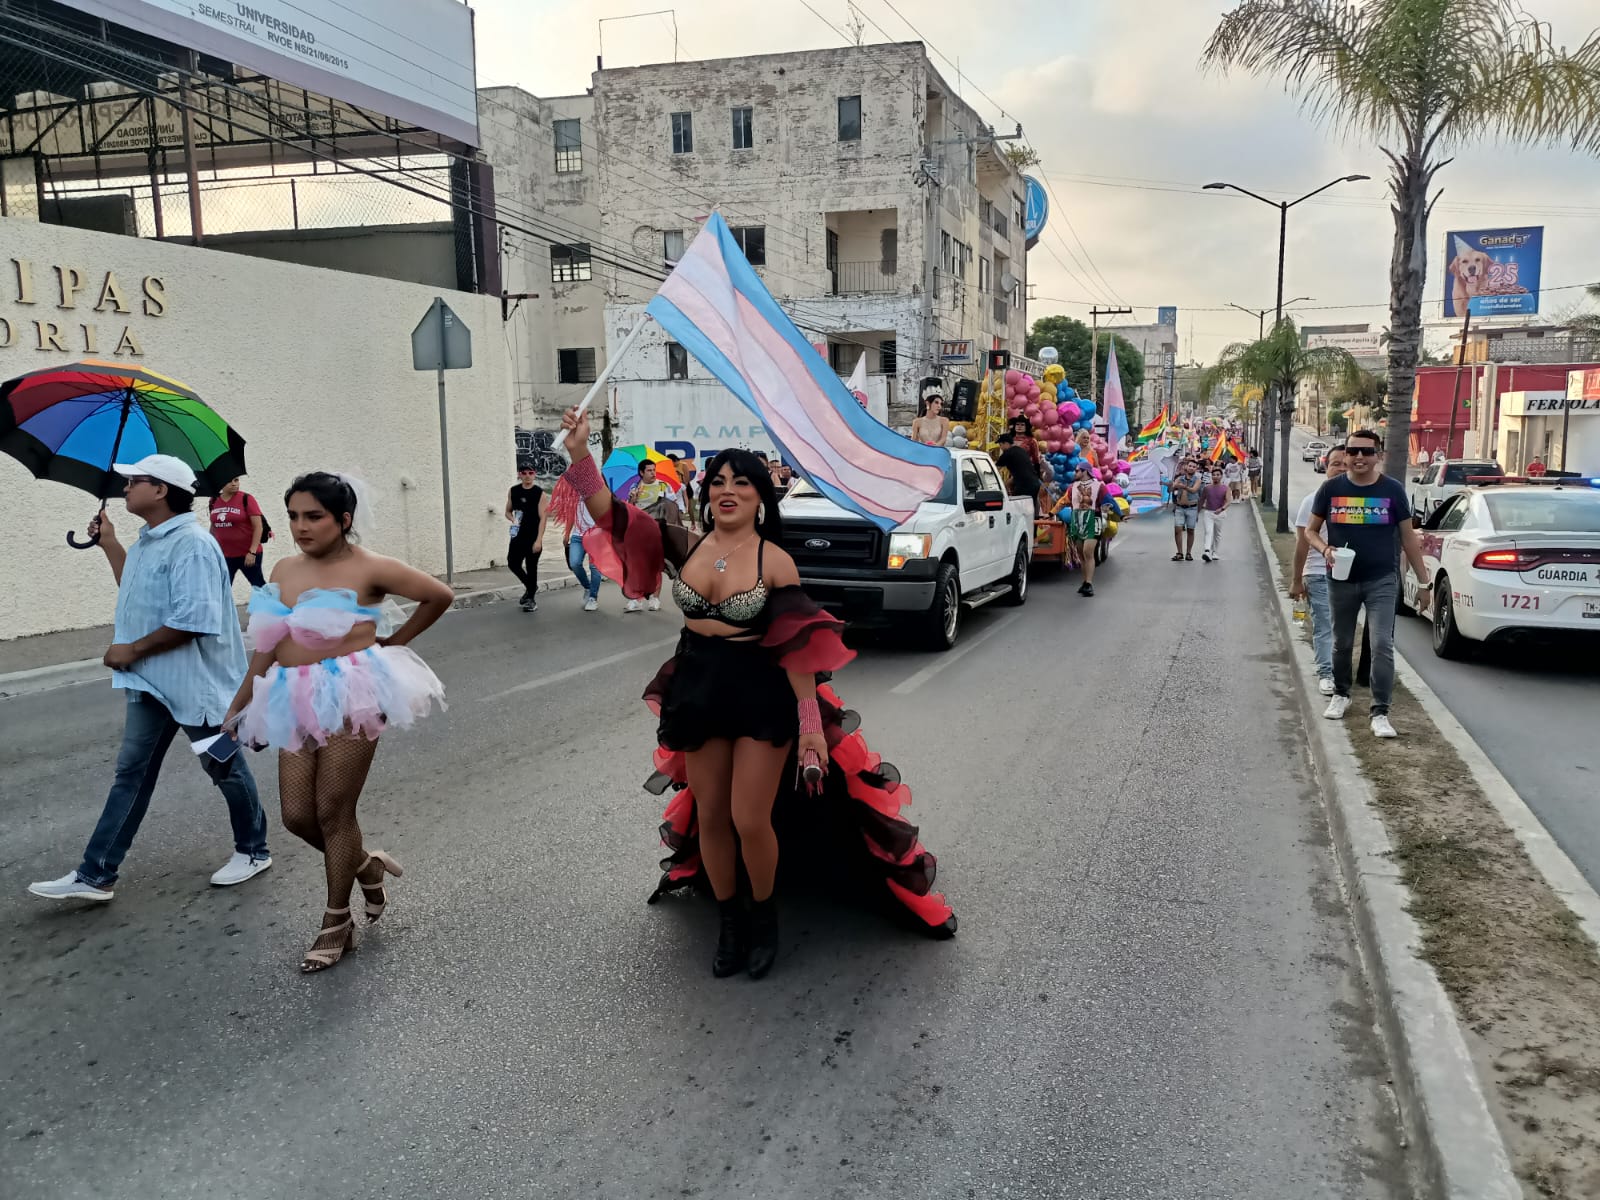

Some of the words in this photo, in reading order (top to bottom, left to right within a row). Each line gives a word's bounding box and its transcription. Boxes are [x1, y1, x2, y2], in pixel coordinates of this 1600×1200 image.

[198, 3, 257, 35] SEMESTRAL
[267, 31, 292, 49] RVOE
[236, 3, 315, 44] UNIVERSIDAD
[1488, 262, 1519, 286] 25
[943, 343, 967, 356] LTH
[1538, 569, 1588, 581] GUARDIA
[1461, 594, 1474, 608] 1721
[1501, 594, 1541, 610] 1721
